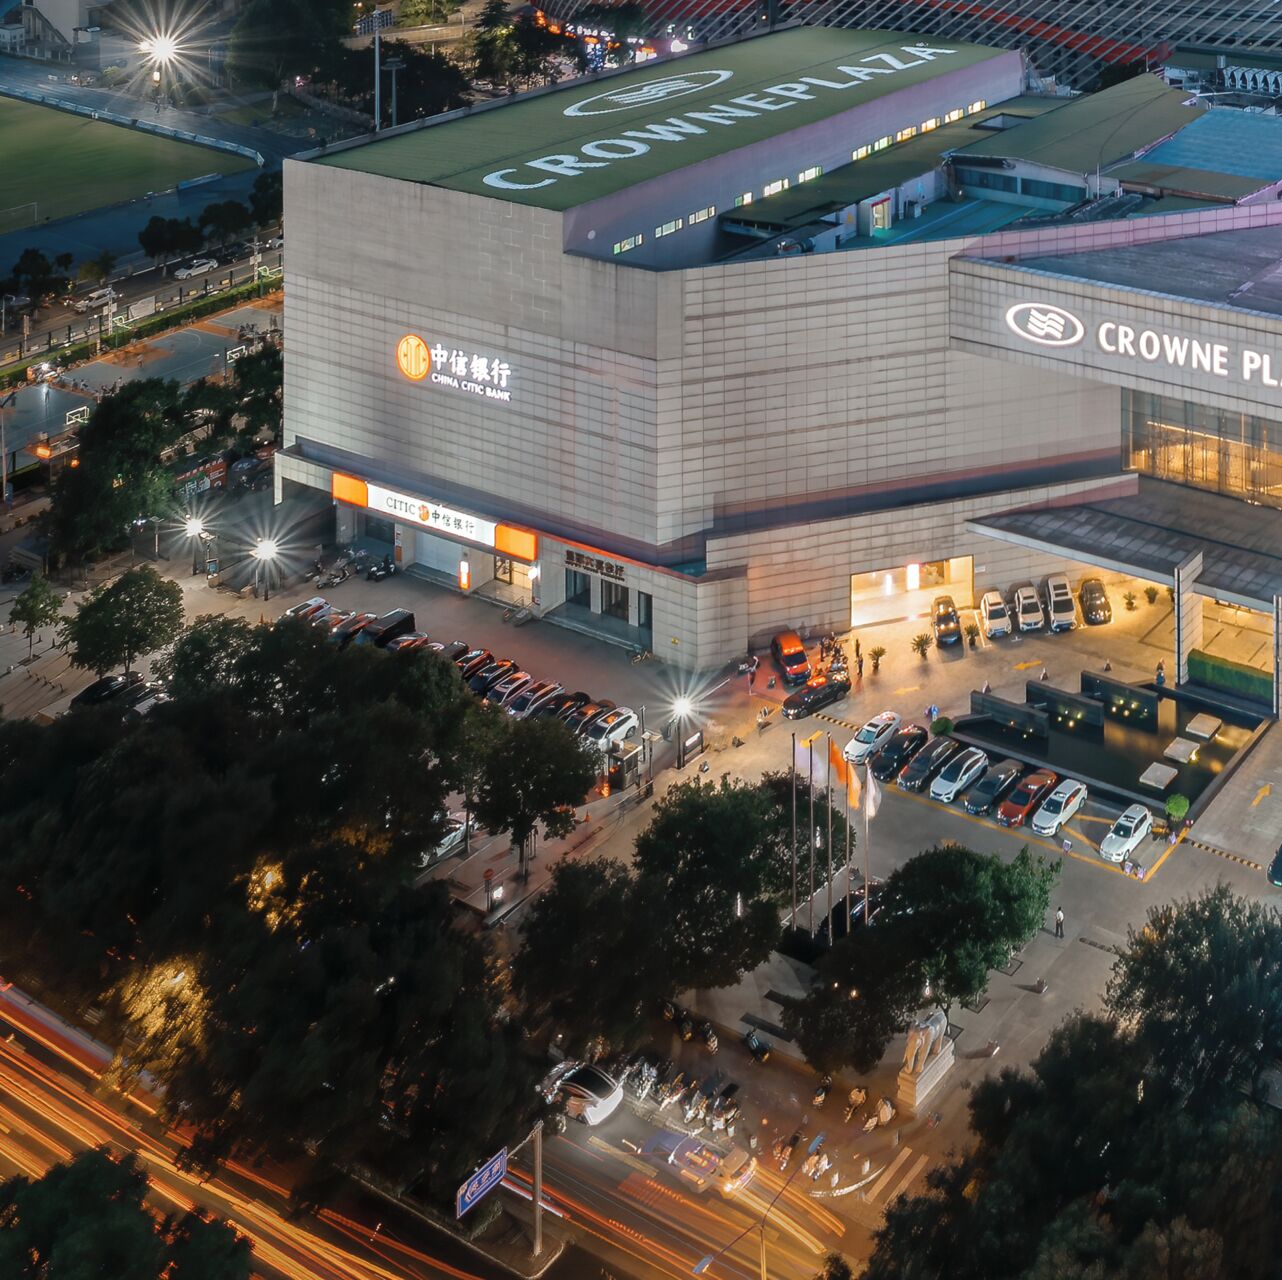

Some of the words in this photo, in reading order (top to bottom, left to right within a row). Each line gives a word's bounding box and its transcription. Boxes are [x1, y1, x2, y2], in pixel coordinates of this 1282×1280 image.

[1098, 322, 1229, 376] CROWNE
[430, 343, 512, 388] 中信银行
[431, 372, 460, 389] CHINA
[461, 381, 484, 395] CITIC
[485, 386, 512, 401] BANK
[386, 496, 416, 515] CITIC
[431, 509, 475, 534] 中信银行
